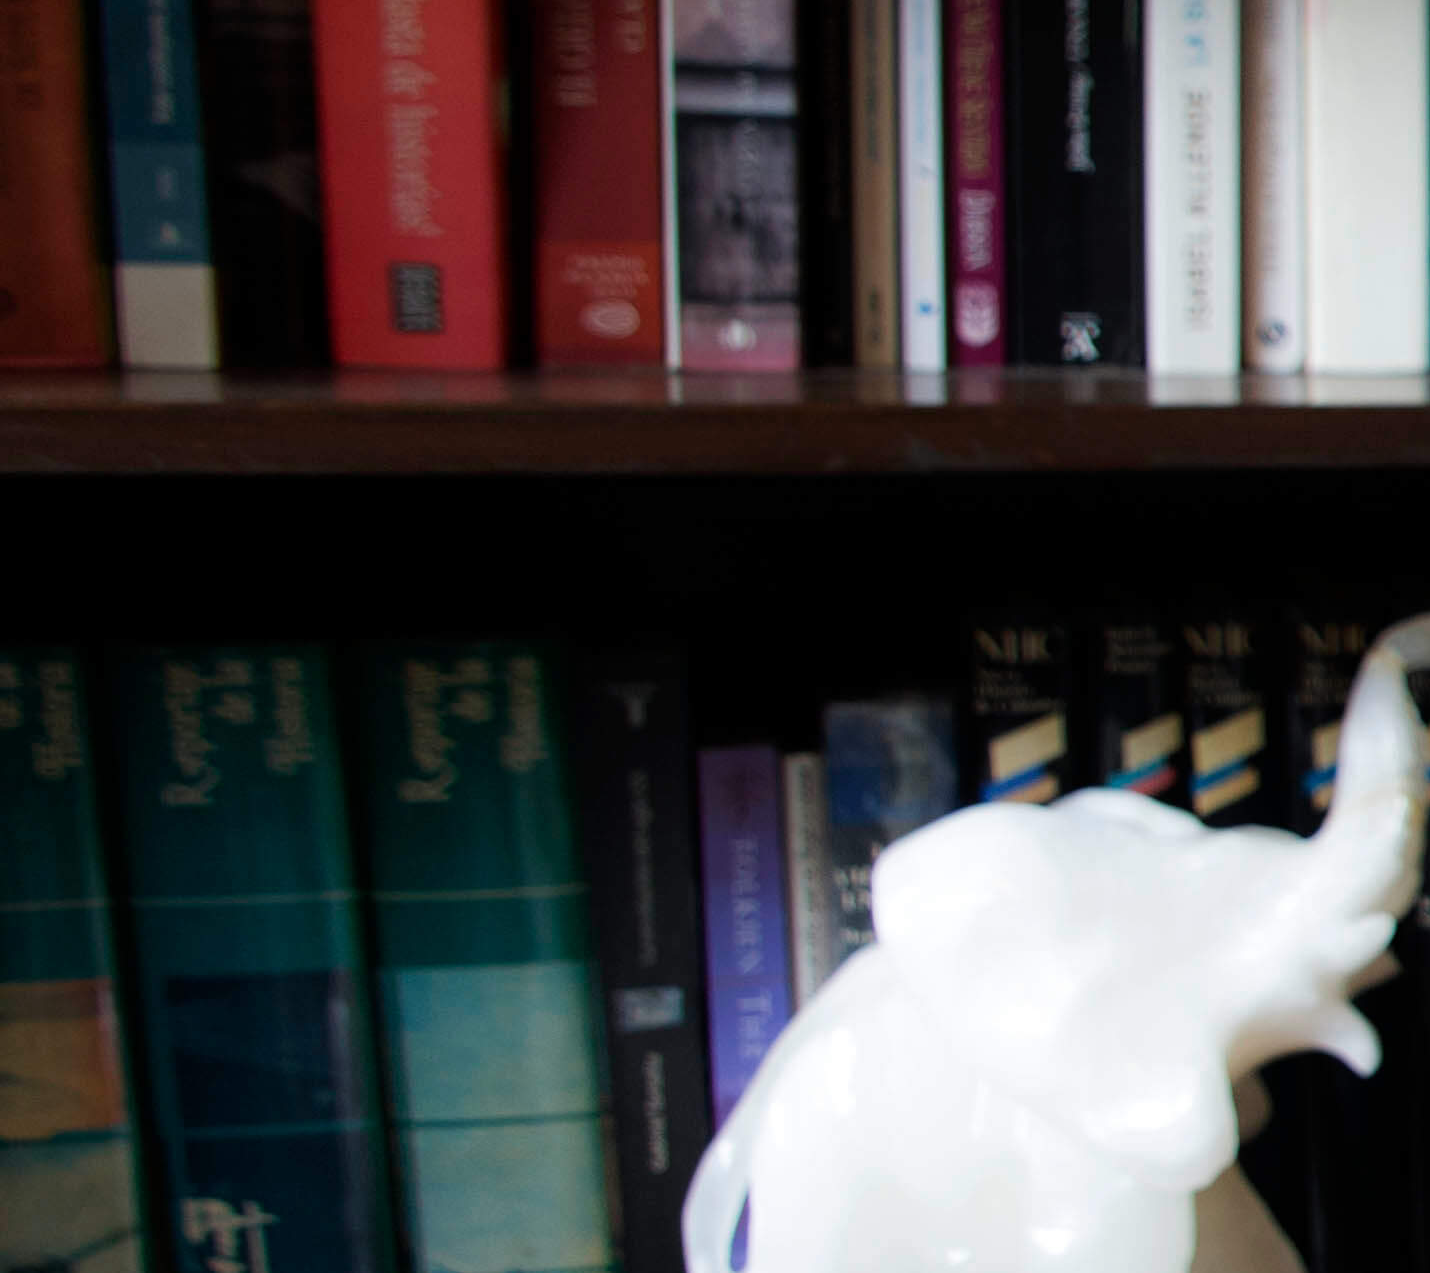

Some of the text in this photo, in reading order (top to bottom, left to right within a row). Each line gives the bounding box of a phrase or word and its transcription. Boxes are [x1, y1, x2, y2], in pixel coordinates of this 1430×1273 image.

[1181, 88, 1214, 332] ISABEL ALLENDE
[30, 658, 85, 780] Historia
[161, 656, 222, 807] Reportaje
[262, 656, 316, 776] Historia
[394, 656, 460, 804] Reportaje
[501, 656, 552, 776] Historia
